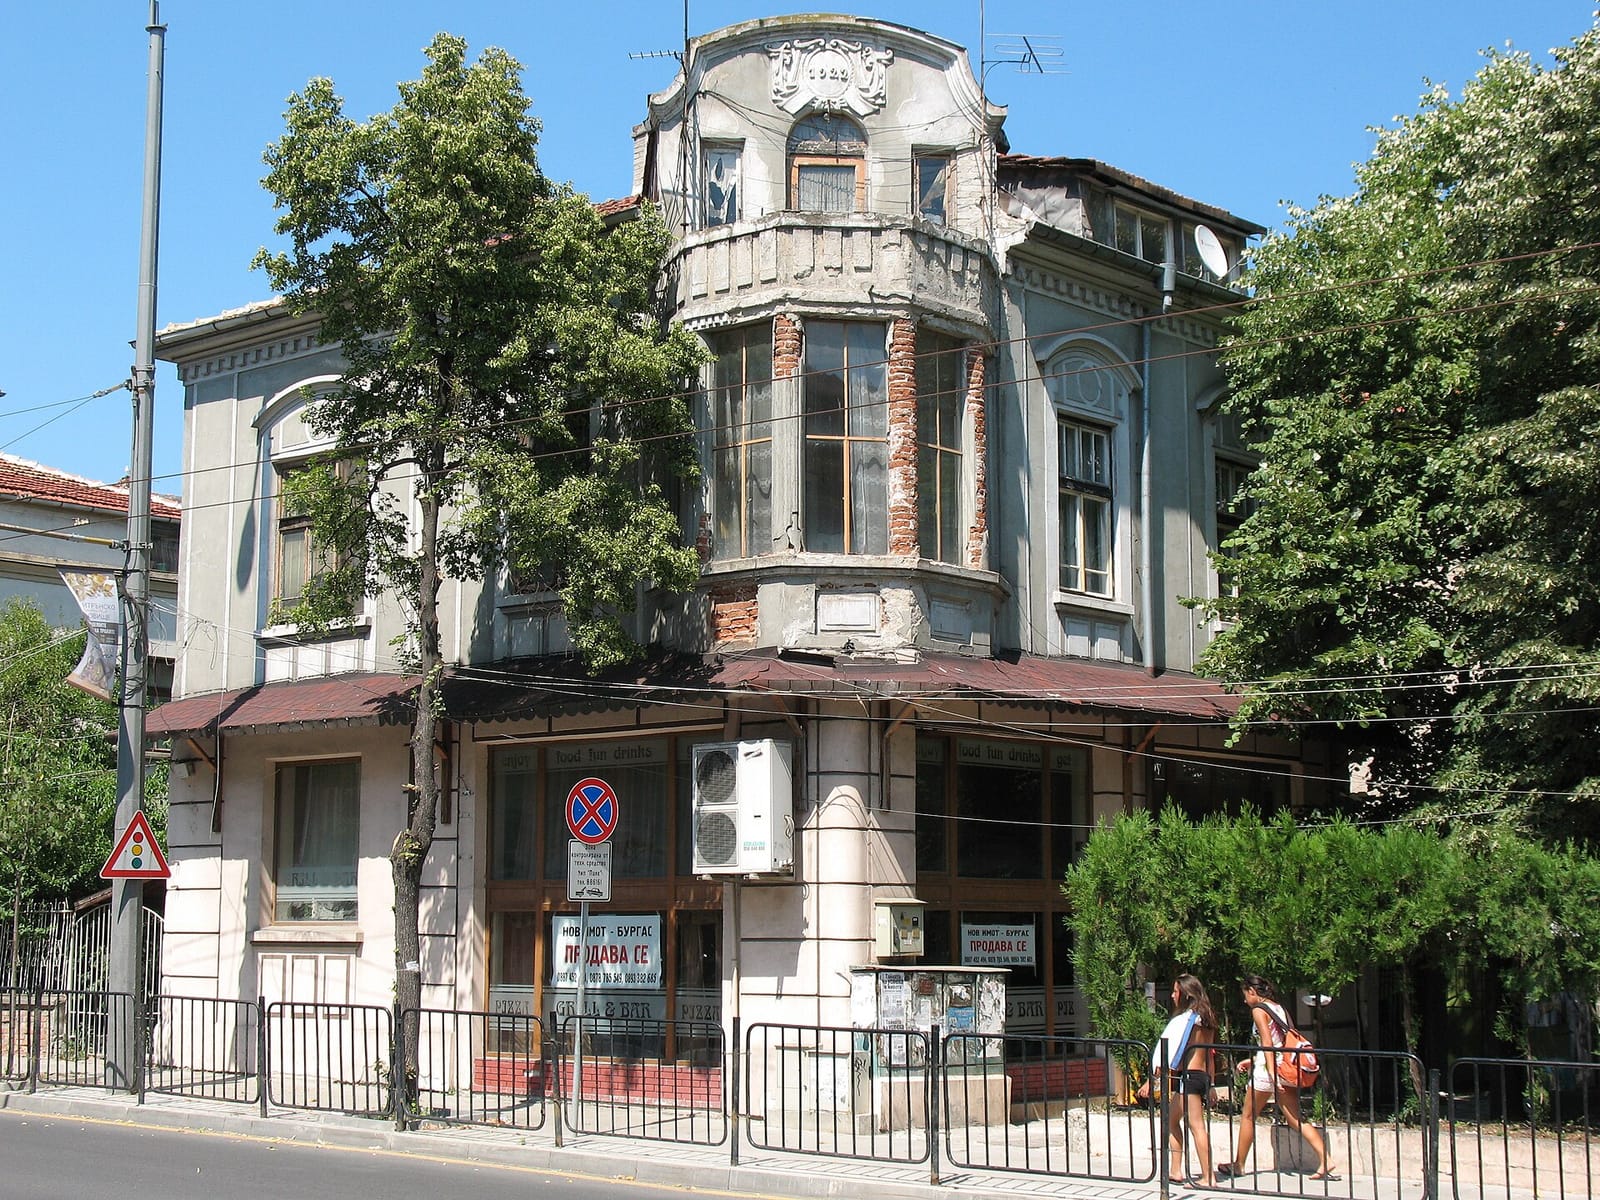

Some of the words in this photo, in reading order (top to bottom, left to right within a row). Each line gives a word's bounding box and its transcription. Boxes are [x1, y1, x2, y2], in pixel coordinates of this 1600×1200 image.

[557, 750, 581, 764] food
[589, 748, 607, 761] fun
[614, 745, 651, 760] drinks
[563, 926, 580, 937] НОВ
[617, 925, 652, 937] БУРГАС
[634, 944, 649, 964] СЕ
[970, 941, 1013, 953] ПРОДАВА
[1016, 941, 1027, 952] СЕ
[495, 1000, 529, 1014] PIZZA
[556, 1000, 600, 1017] GRLL
[605, 1001, 615, 1017] &
[620, 1001, 652, 1018] BAR
[682, 1004, 720, 1021] PIZZA
[1017, 1001, 1044, 1017] BAR
